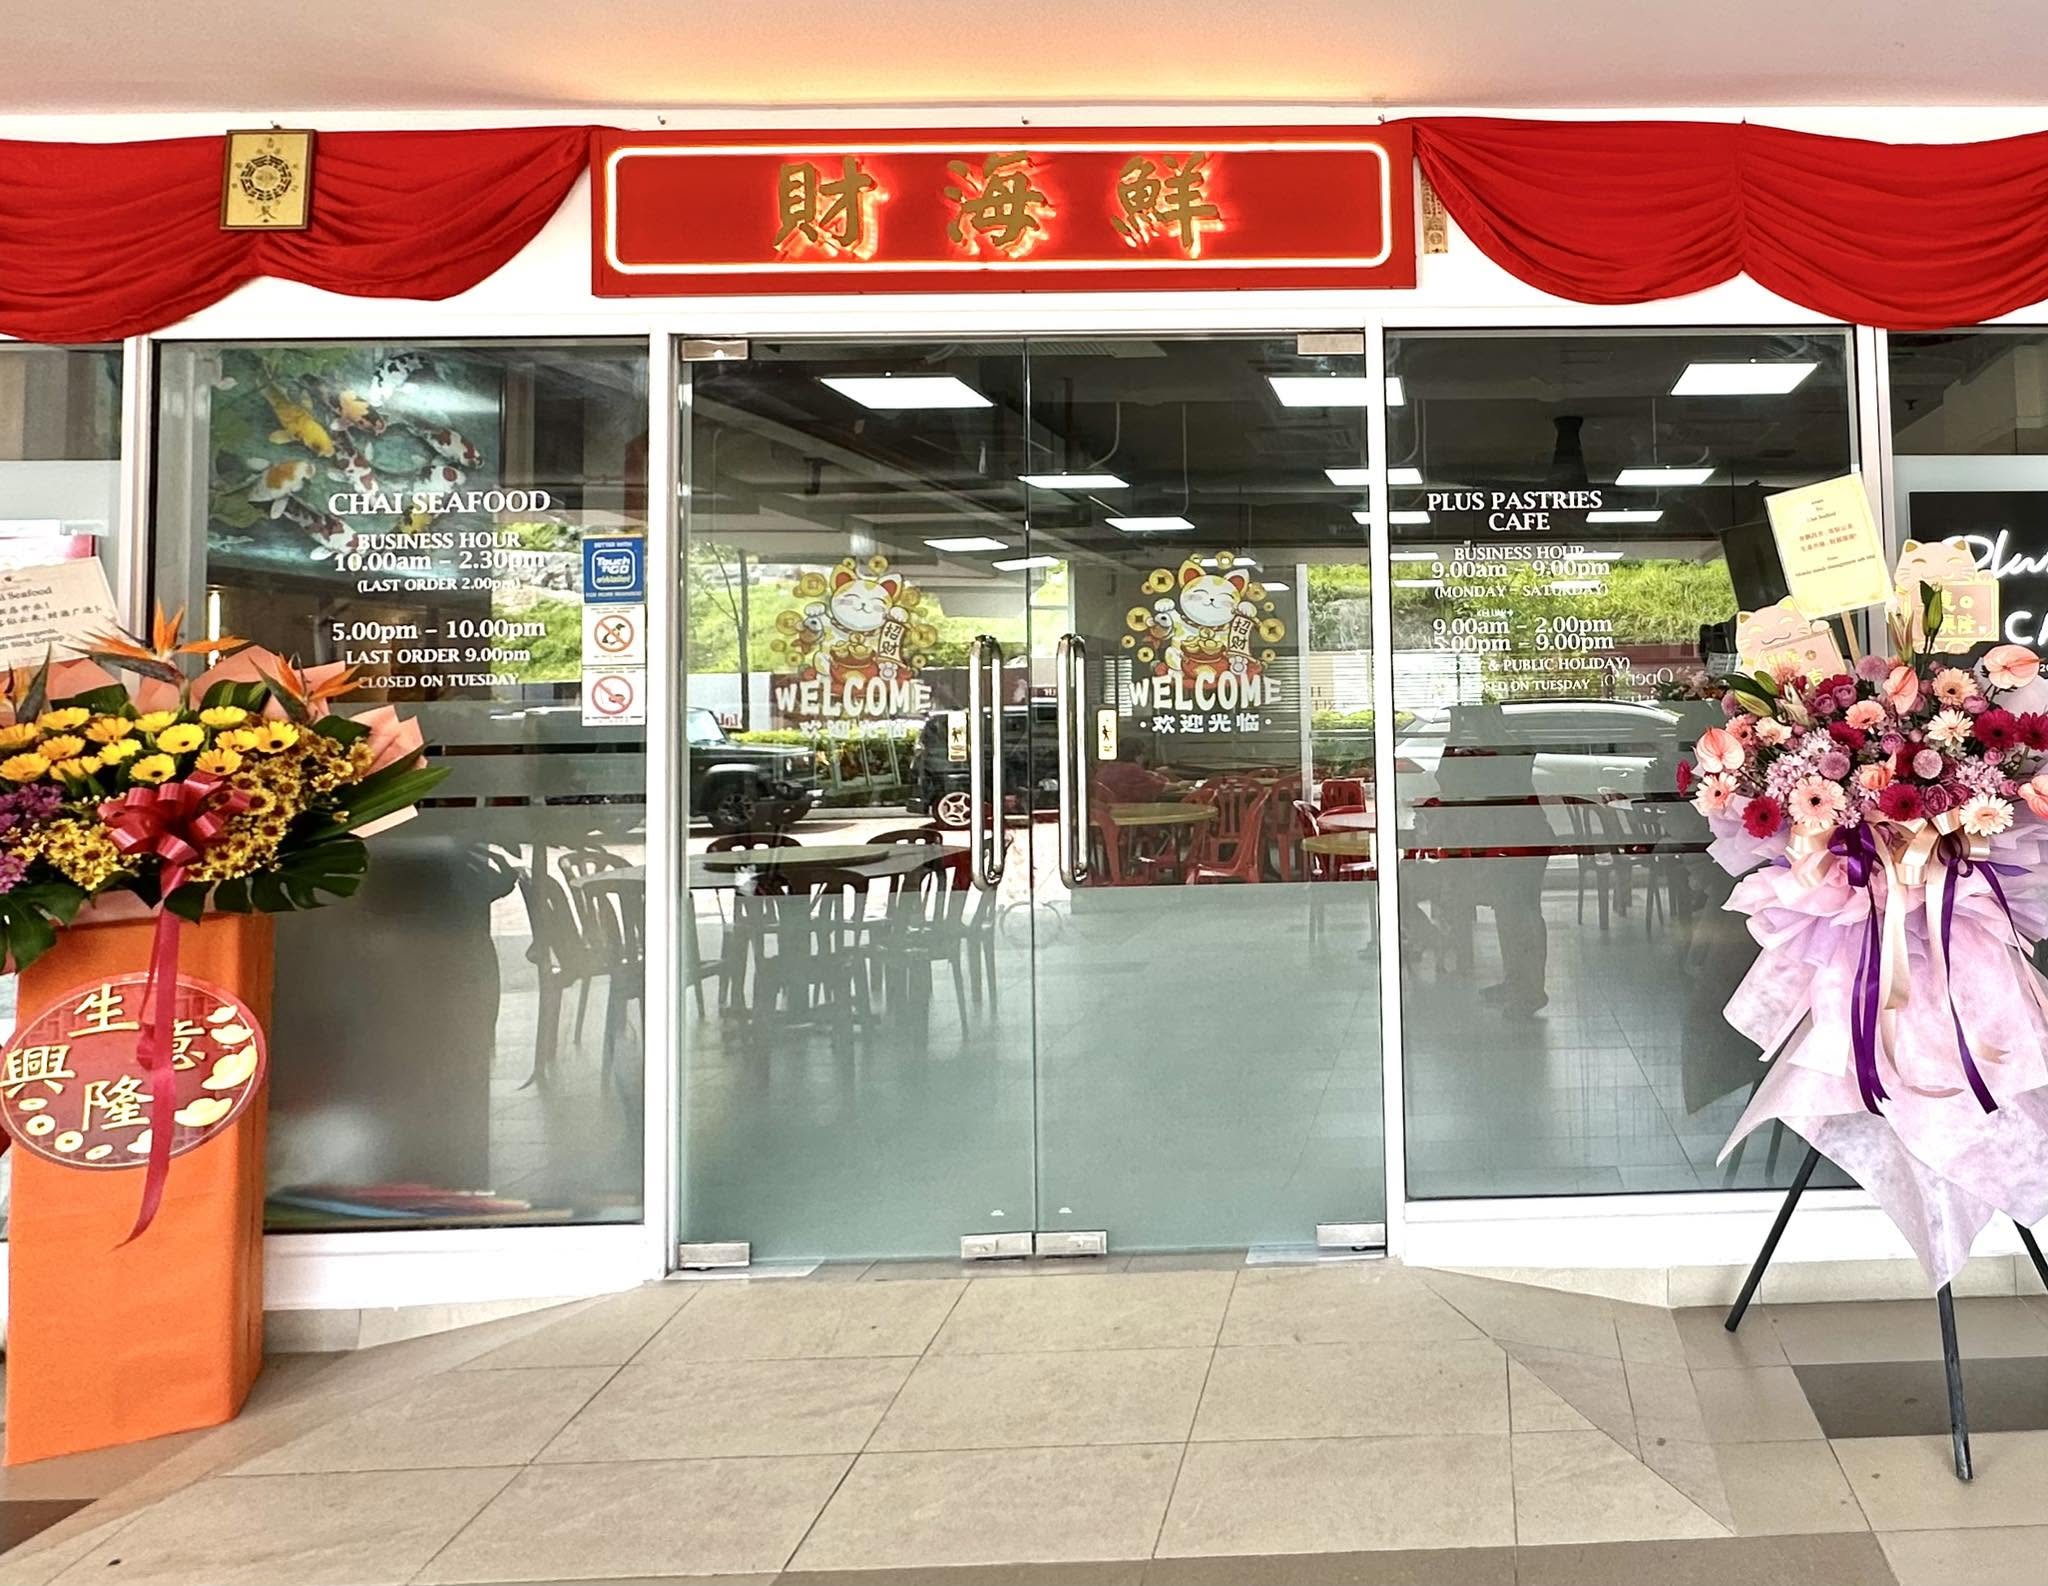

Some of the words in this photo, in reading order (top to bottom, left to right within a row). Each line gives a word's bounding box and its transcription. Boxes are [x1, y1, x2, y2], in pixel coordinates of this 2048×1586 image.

[775, 151, 1220, 249] 財海鮮
[328, 493, 403, 515] CHAI
[412, 491, 550, 514] SEAFOOD
[1427, 492, 1485, 511] PLUS
[1491, 490, 1603, 510] PASTRIES
[1488, 513, 1550, 531] CAFE
[358, 533, 454, 551] BUSINESS
[459, 532, 522, 548] HOUR
[335, 552, 432, 571] 10.00am
[459, 551, 545, 573] 2.30pm
[1454, 546, 1532, 561] BUSINESS
[1431, 561, 1508, 578] 9.00am
[1532, 560, 1611, 580] 9.00pm
[8, 586, 53, 600] Seafood
[357, 579, 401, 593] (LAST
[406, 578, 457, 591] ORDER
[461, 577, 521, 592] 2.00pm)
[1434, 586, 1506, 600] (MONDAY
[332, 621, 418, 644] 5.00pm
[446, 619, 545, 641] 10.00pm
[1231, 618, 1250, 651] 招财
[1432, 618, 1510, 635] 9.00am
[1535, 616, 1613, 636] 2.00pm
[1433, 635, 1511, 655] 5.00pm
[1535, 633, 1614, 653] 9.00pm
[346, 650, 392, 665] LAST
[397, 649, 460, 664] ORDER
[465, 648, 530, 663] 9.00pm
[1488, 659, 1500, 671] &
[1503, 658, 1556, 672] PUBLIC
[1558, 657, 1631, 672] HOLIDAY)
[358, 676, 417, 689] CLOSED
[420, 675, 443, 687] ON
[447, 674, 519, 687] TUESDAY
[1129, 670, 1282, 711] WELCOME
[1511, 681, 1529, 691] ON
[1532, 679, 1590, 691] TUESDAY
[775, 676, 932, 716] WELCOME
[1152, 712, 1260, 734] 欢迎光临
